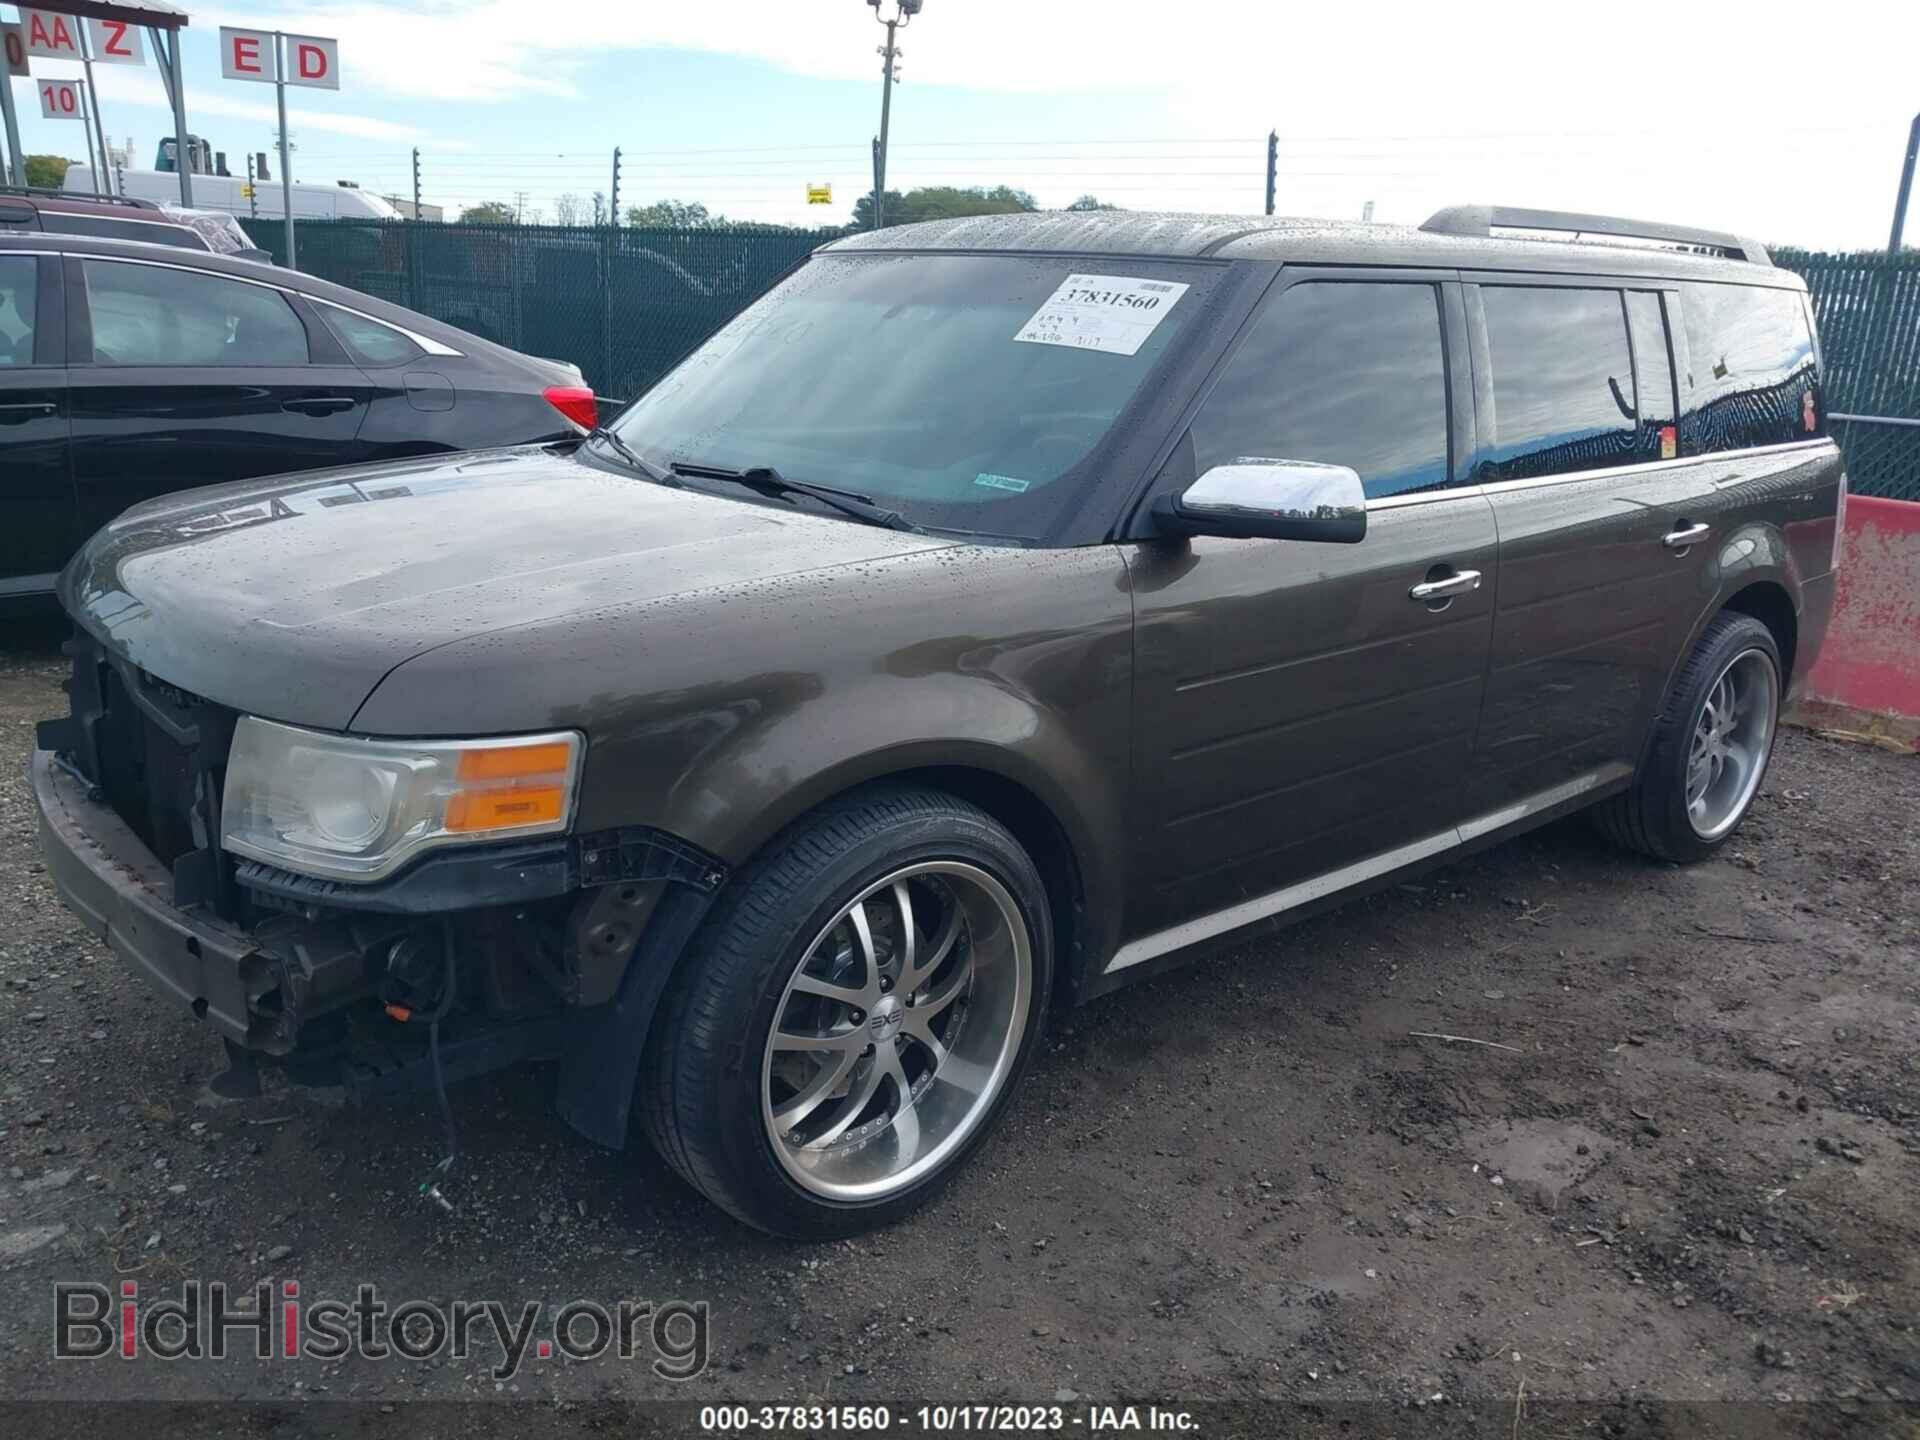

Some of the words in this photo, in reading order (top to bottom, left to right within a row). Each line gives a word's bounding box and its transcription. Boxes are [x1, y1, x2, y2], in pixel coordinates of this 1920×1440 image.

[30, 13, 75, 51] AA
[102, 21, 132, 56] Z
[233, 37, 262, 73] E
[299, 43, 327, 79] D
[43, 86, 75, 112] 10
[1060, 288, 1160, 311] 37831560
